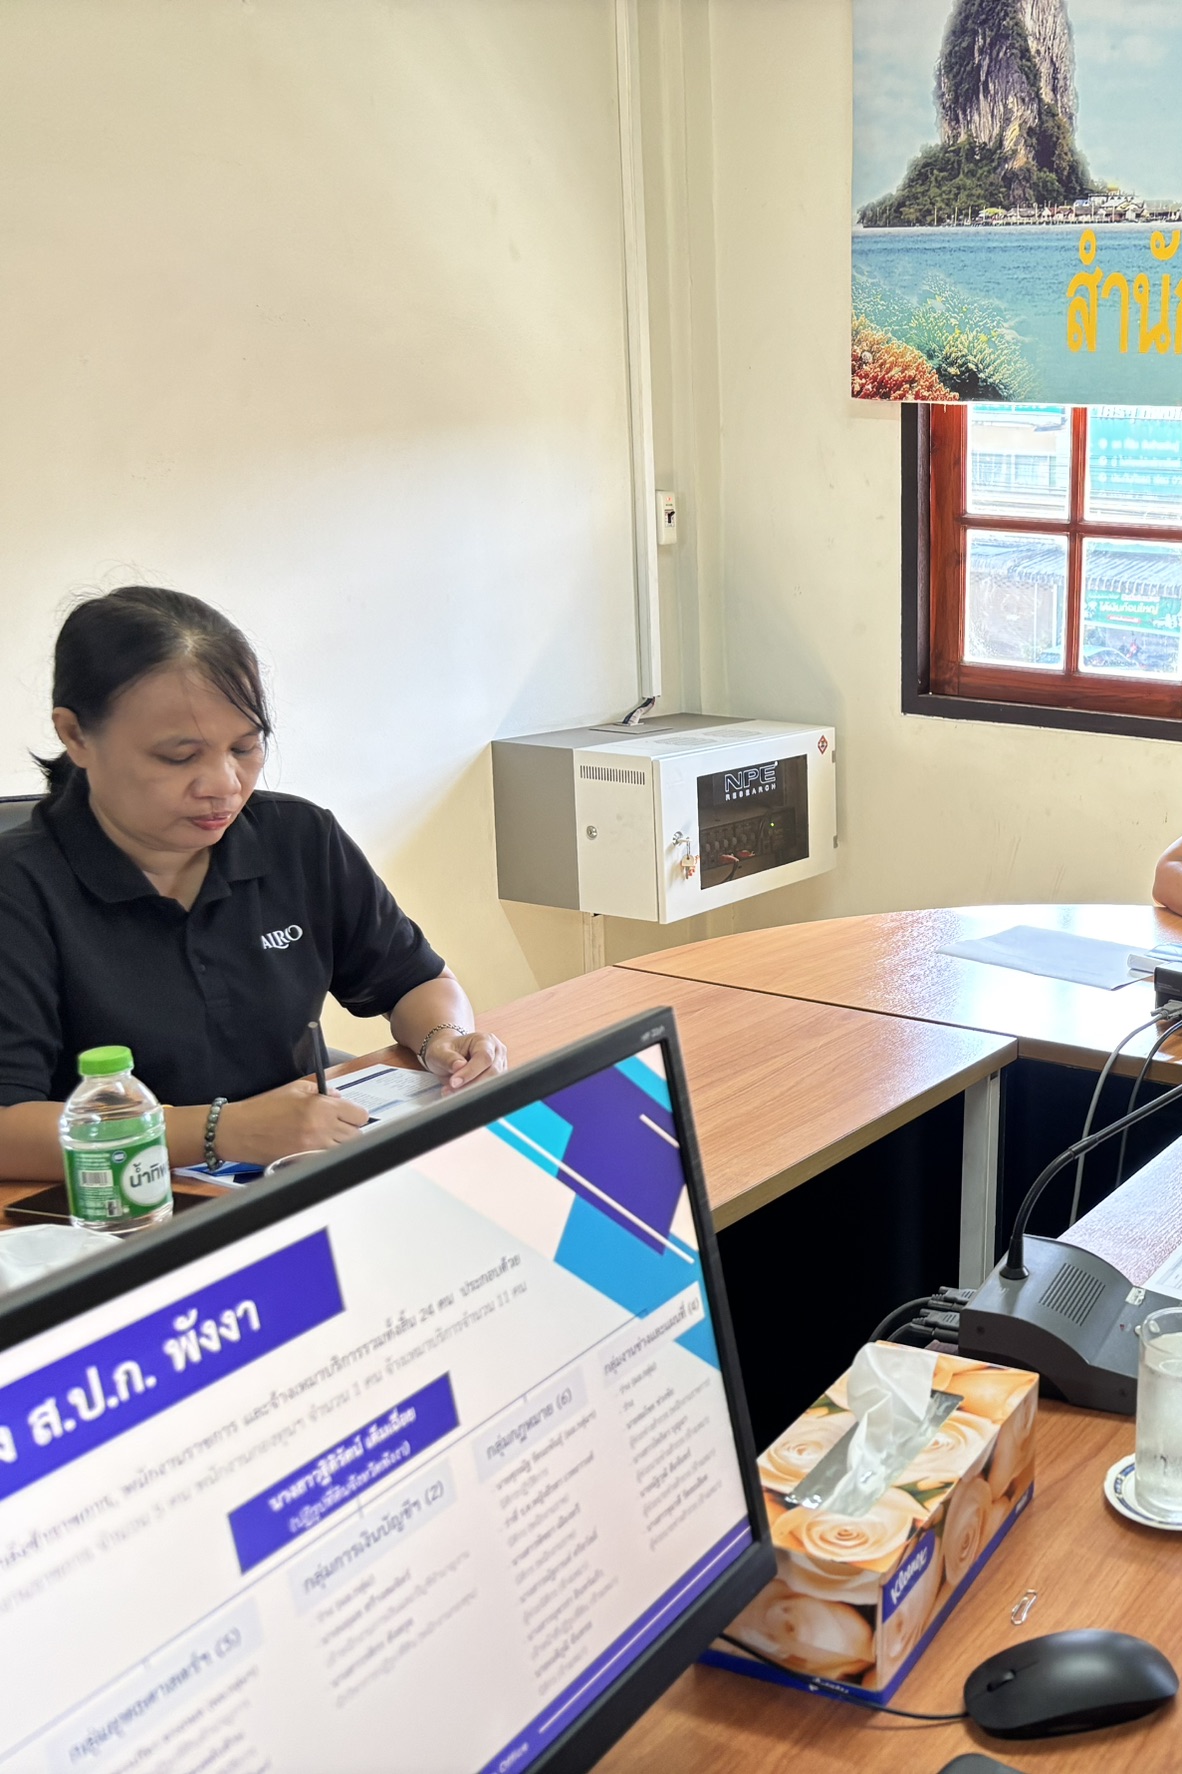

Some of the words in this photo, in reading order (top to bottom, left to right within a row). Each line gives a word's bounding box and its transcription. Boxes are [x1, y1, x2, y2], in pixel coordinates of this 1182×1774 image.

[724, 764, 777, 793] NPE
[725, 783, 776, 801] RESEARCH
[28, 1367, 157, 1446] ส.ป.ก.
[164, 1298, 261, 1372] พังงา
